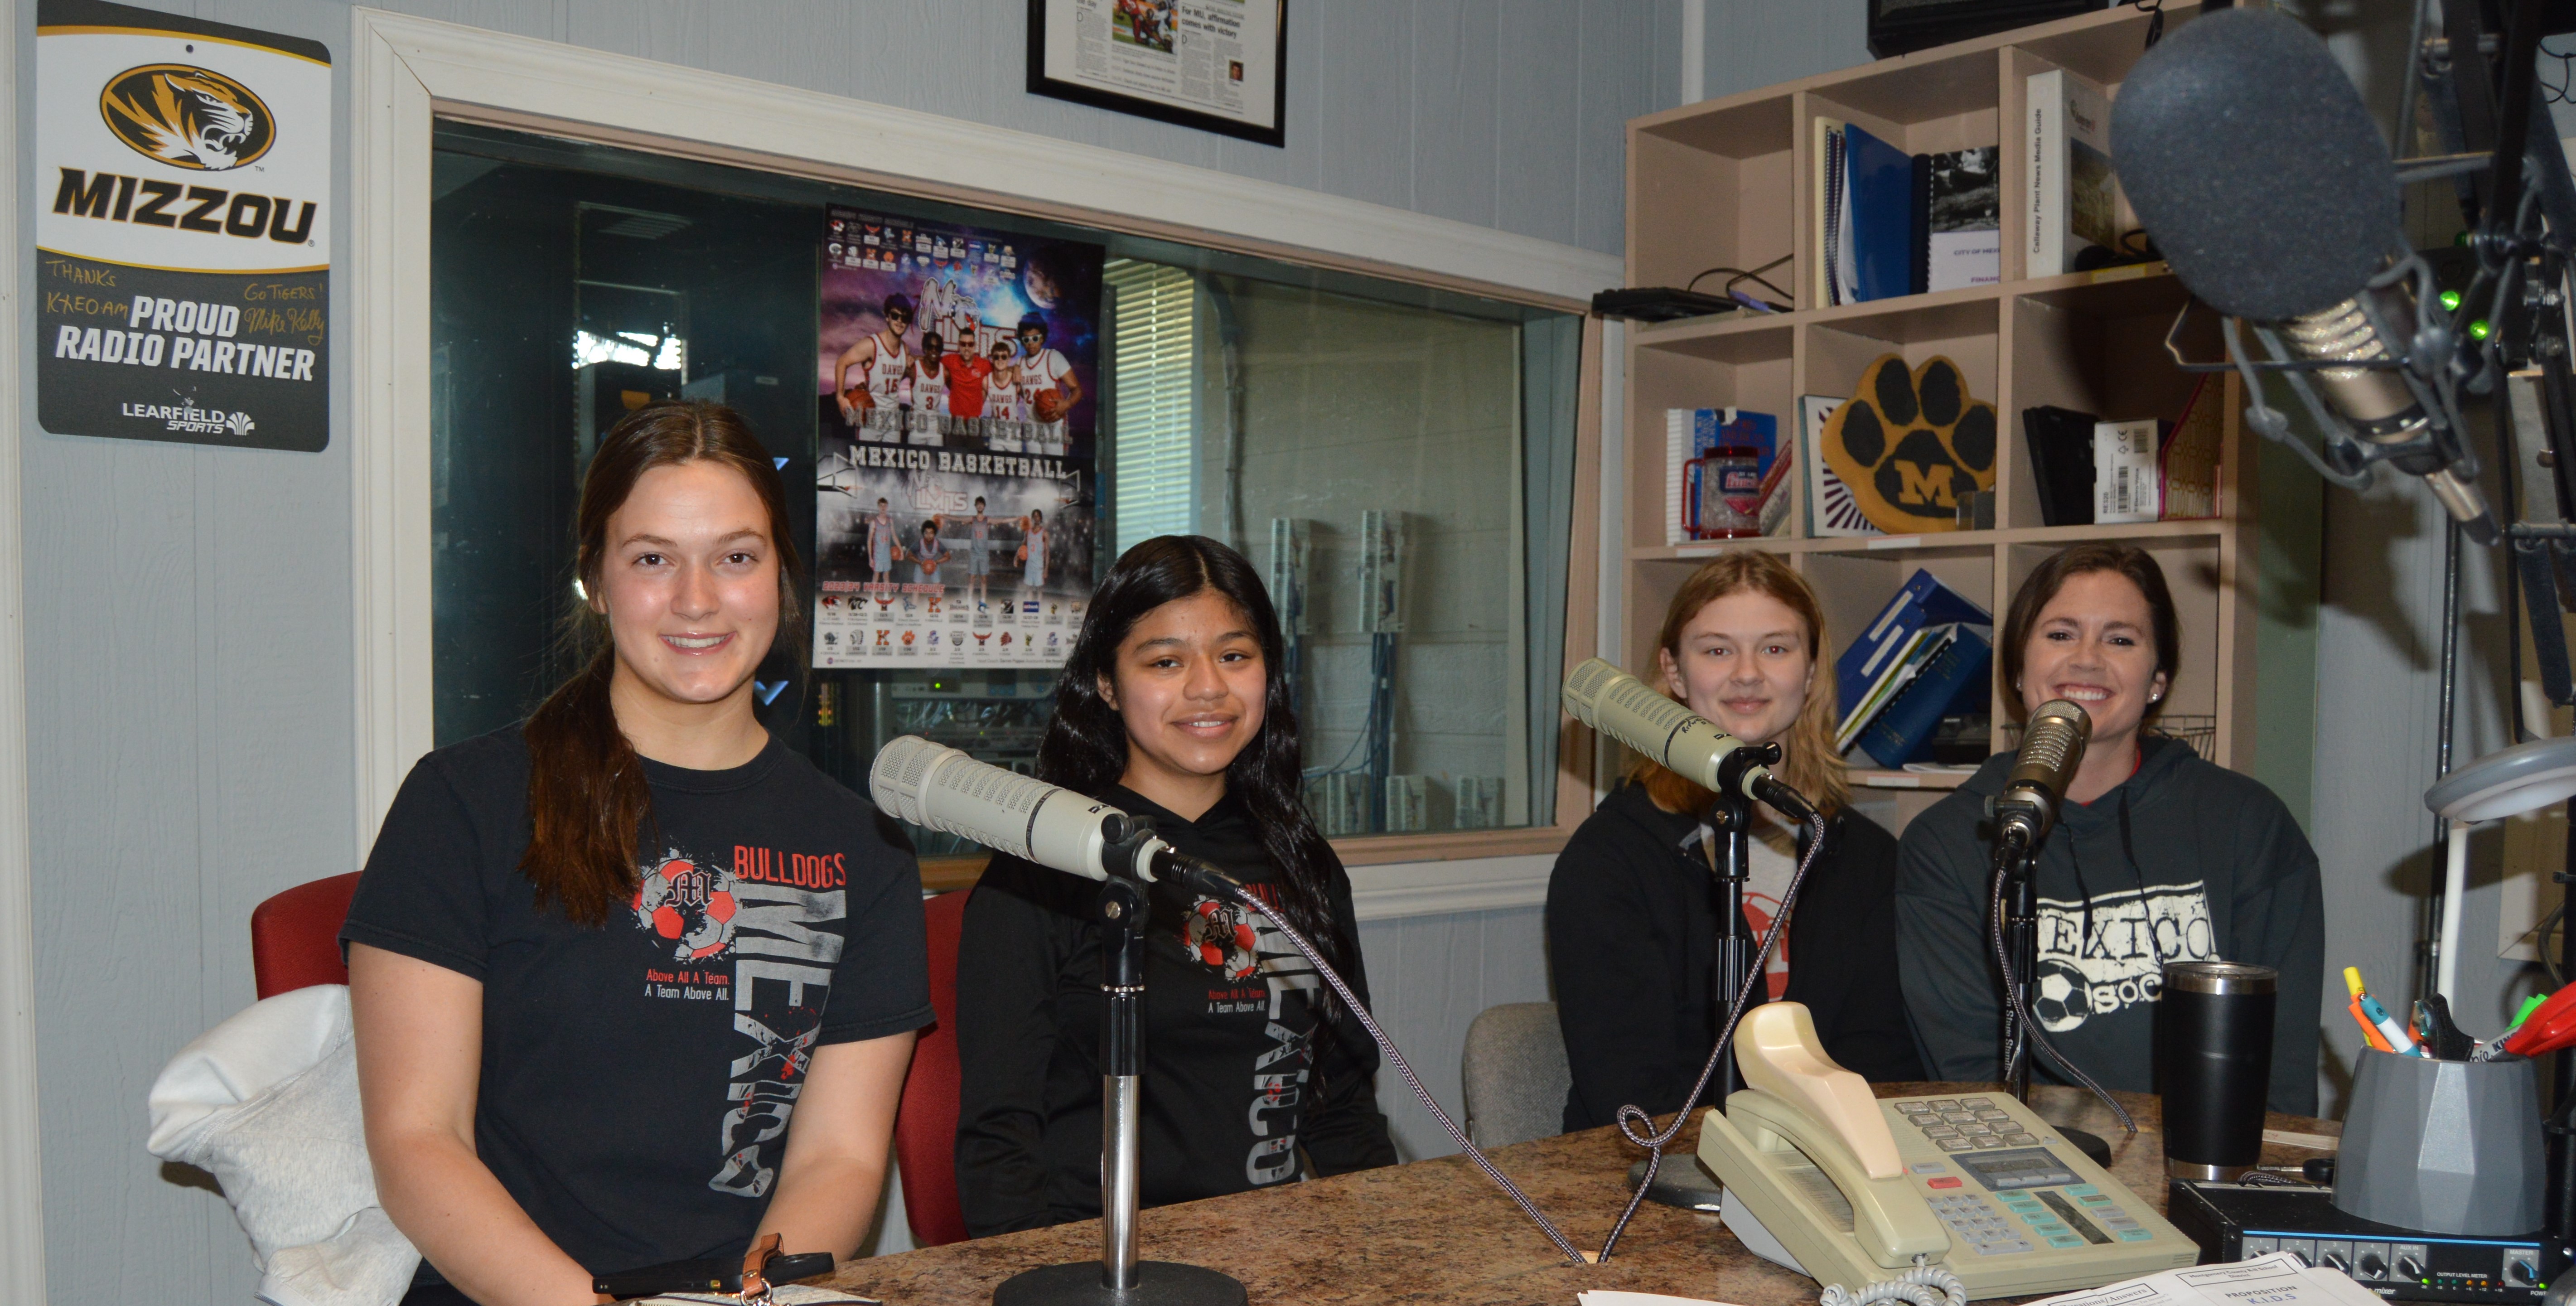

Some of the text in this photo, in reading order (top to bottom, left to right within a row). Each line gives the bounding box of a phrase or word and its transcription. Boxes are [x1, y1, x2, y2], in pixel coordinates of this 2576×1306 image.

[1182, 5, 1240, 28] For MU, affirmation
[1182, 19, 1237, 39] comes with victory
[52, 166, 318, 245] MIZZOU
[2033, 215, 2042, 254] Callaway
[45, 260, 116, 287] THANKS
[129, 295, 240, 338] PROUD
[244, 307, 286, 335] Mike
[55, 325, 315, 381] RADIO PARTNER
[920, 383, 940, 393] DAWGS
[1022, 374, 1042, 385] DAWGS
[925, 396, 933, 410] 3
[991, 393, 1012, 403] DAWGS
[122, 403, 225, 423] LEARFIELD
[996, 406, 1010, 420] 14
[167, 421, 225, 434] SPORTS
[938, 415, 1073, 444] BASKETBALL
[849, 445, 1067, 479] MEXICO BASKETBALL
[1894, 459, 1958, 509] M
[863, 582, 900, 592] VARSITY
[901, 583, 945, 593] SCHEDULE
[734, 845, 846, 889] BULLDOGS
[2038, 914, 2211, 960] EXICO
[646, 969, 730, 985] Above All A Team.
[645, 985, 730, 1001] A Team Above All.
[1208, 989, 1228, 1000] Above
[1230, 989, 1239, 999] All
[1240, 989, 1247, 998] A
[1208, 1001, 1266, 1013] A Team Above All.
[2006, 1010, 2014, 1037] Stage
[708, 881, 846, 1198] MEXICO
[2005, 1038, 2014, 1071] Stands
[2225, 1285, 2297, 1298] PROPOSITION
[2247, 1293, 2296, 1304] K.I.D.S
